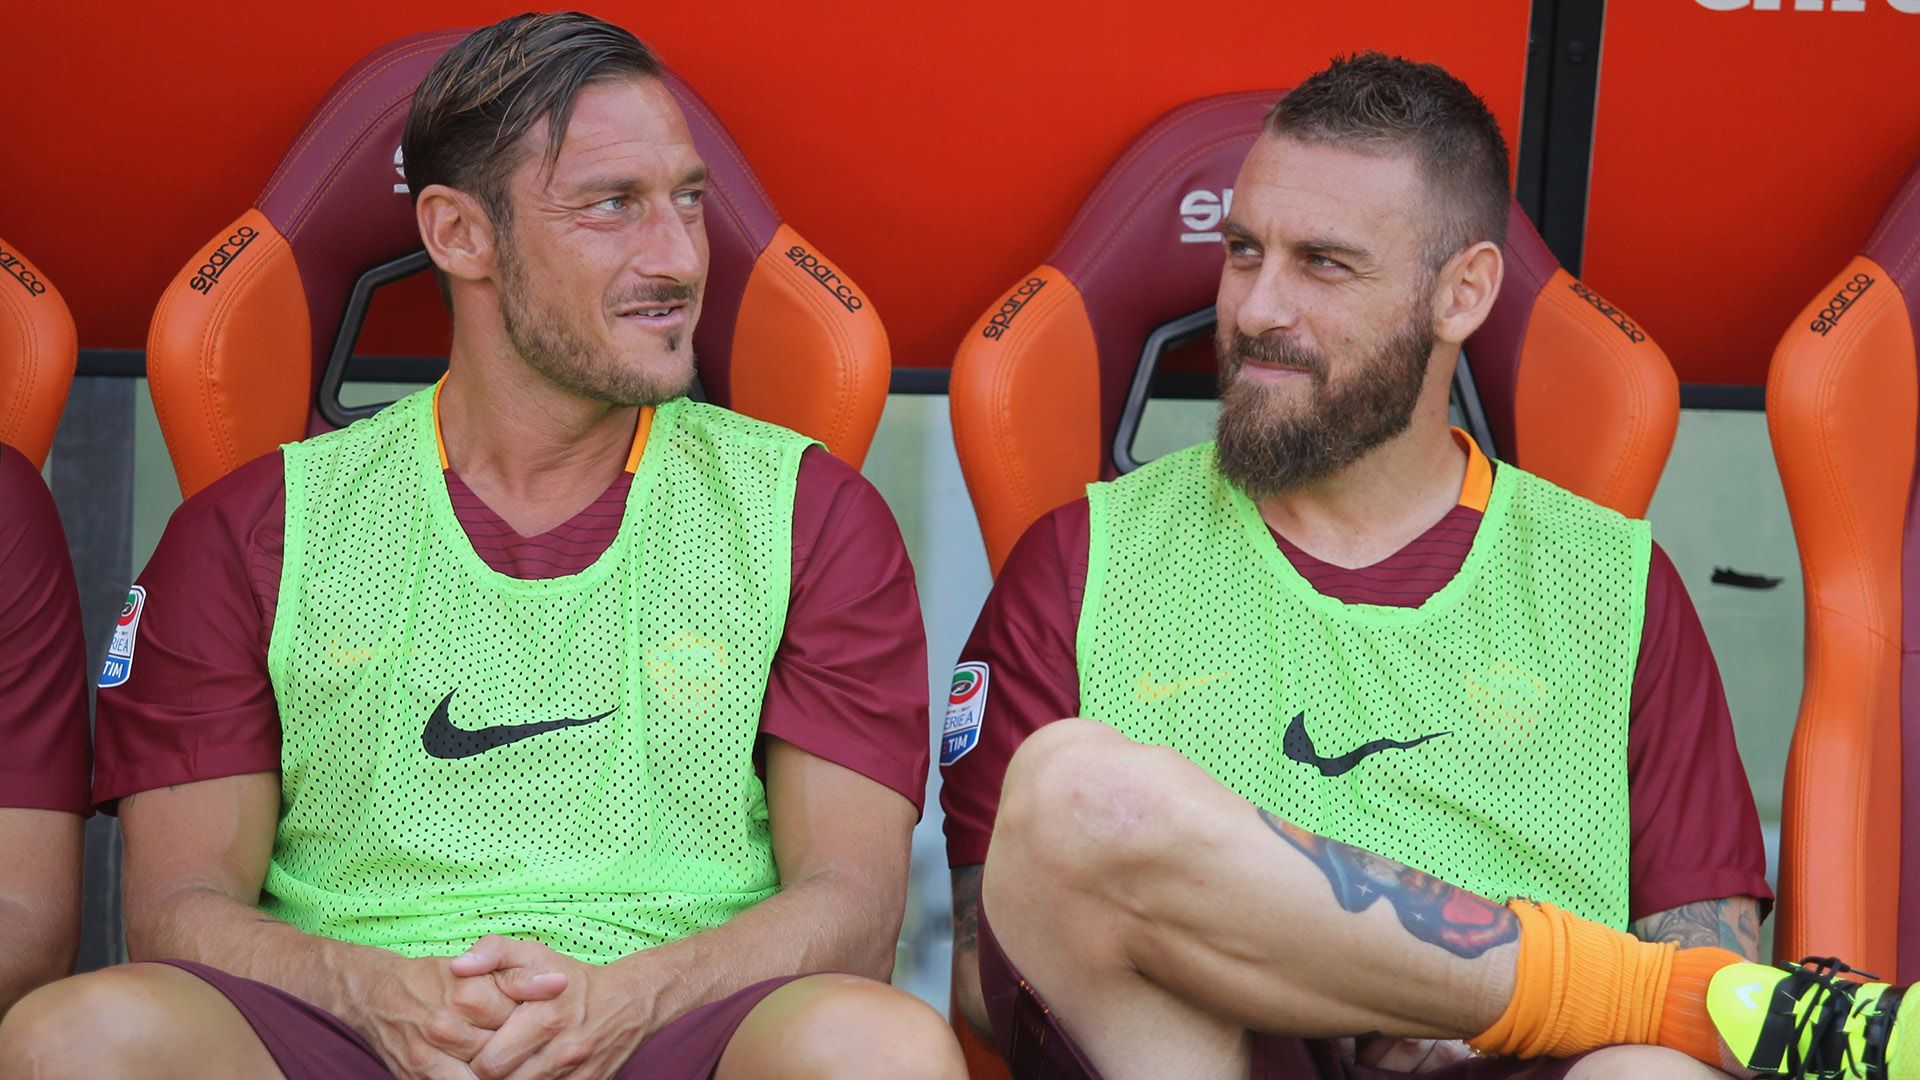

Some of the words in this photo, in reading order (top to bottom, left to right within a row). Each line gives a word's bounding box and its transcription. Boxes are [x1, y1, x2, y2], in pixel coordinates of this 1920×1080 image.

[0, 247, 46, 297] arco
[190, 226, 259, 295] sparco
[784, 245, 862, 313] sparco
[983, 277, 1048, 341] sparco
[1810, 273, 1876, 337] sparco
[103, 661, 123, 678] TIM
[948, 734, 968, 753] TIM
